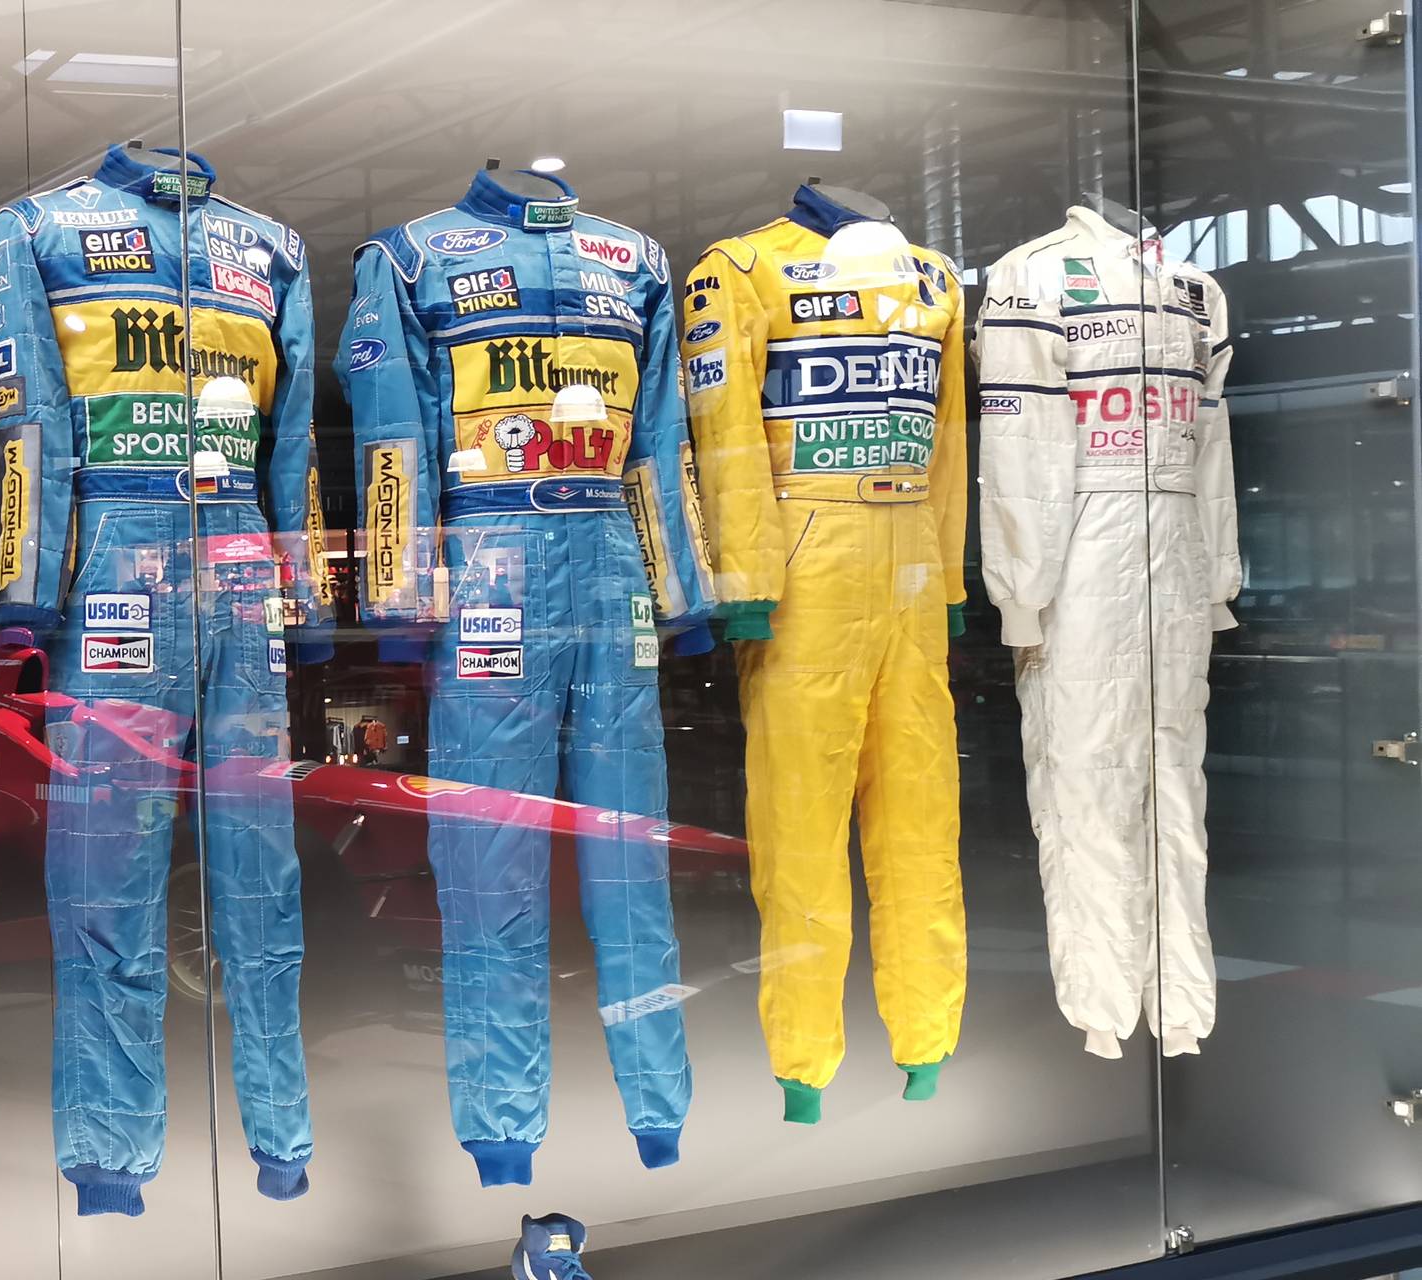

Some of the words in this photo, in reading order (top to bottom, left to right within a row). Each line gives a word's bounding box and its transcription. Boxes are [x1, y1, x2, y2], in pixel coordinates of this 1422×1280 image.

[50, 208, 138, 225] RENAULT
[534, 206, 560, 215] UNITED
[536, 213, 546, 222] OF
[85, 231, 123, 252] elf
[204, 216, 259, 248] MILD
[443, 230, 490, 251] Ford
[579, 238, 632, 264] SANYO
[89, 254, 152, 272] MINOL
[791, 264, 827, 281] Ford
[453, 272, 491, 295] elf
[579, 271, 626, 297] MILD
[456, 292, 518, 315] MINOL
[585, 294, 642, 326] SEVEN
[793, 295, 834, 318] elf
[354, 312, 379, 329] EVEN
[1066, 318, 1138, 342] BOBACH
[485, 338, 620, 396] Bitburger
[692, 369, 724, 389] 440
[798, 418, 890, 443] UNITED
[1089, 429, 1145, 448] DCS
[812, 447, 848, 467] OF
[0, 446, 21, 580] TECHNOGYM
[376, 451, 401, 598] TECHNOGYM
[87, 601, 129, 621] USAG
[462, 616, 503, 634] USAG
[88, 646, 146, 660] CHAMPION
[461, 656, 520, 669] CHAMPION
